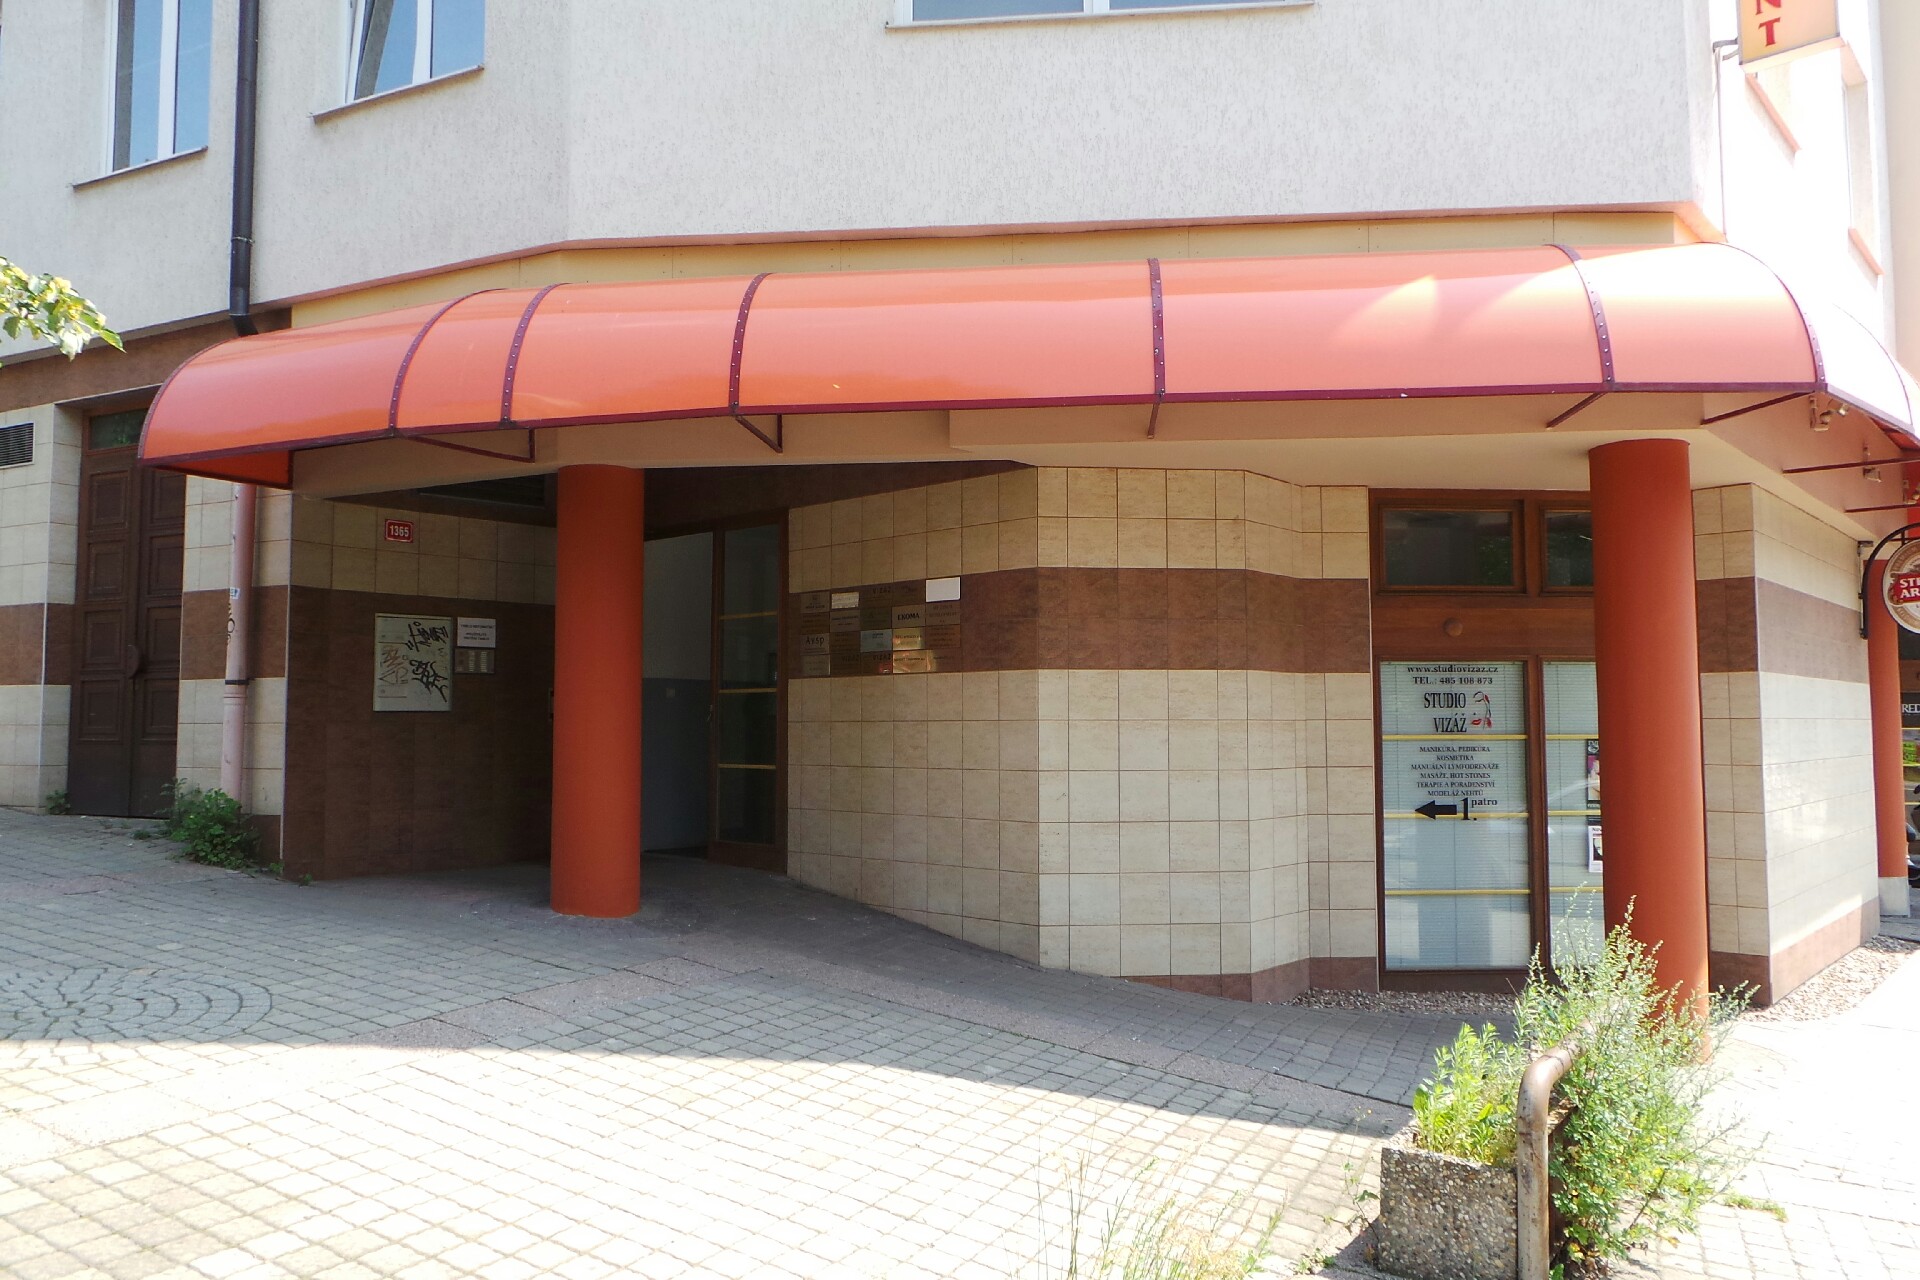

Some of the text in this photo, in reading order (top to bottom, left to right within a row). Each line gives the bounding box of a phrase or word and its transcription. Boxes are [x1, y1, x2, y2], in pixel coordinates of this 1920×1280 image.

[390, 524, 410, 538] 1365
[897, 612, 920, 621] EKOMA
[1407, 664, 1499, 673] www.studiovizaz.cz
[1423, 691, 1467, 709] STUDIO
[1433, 712, 1467, 733] VIZÁŽ
[1427, 789, 1460, 797] MODELÁŽ
[1471, 798, 1498, 808] patro
